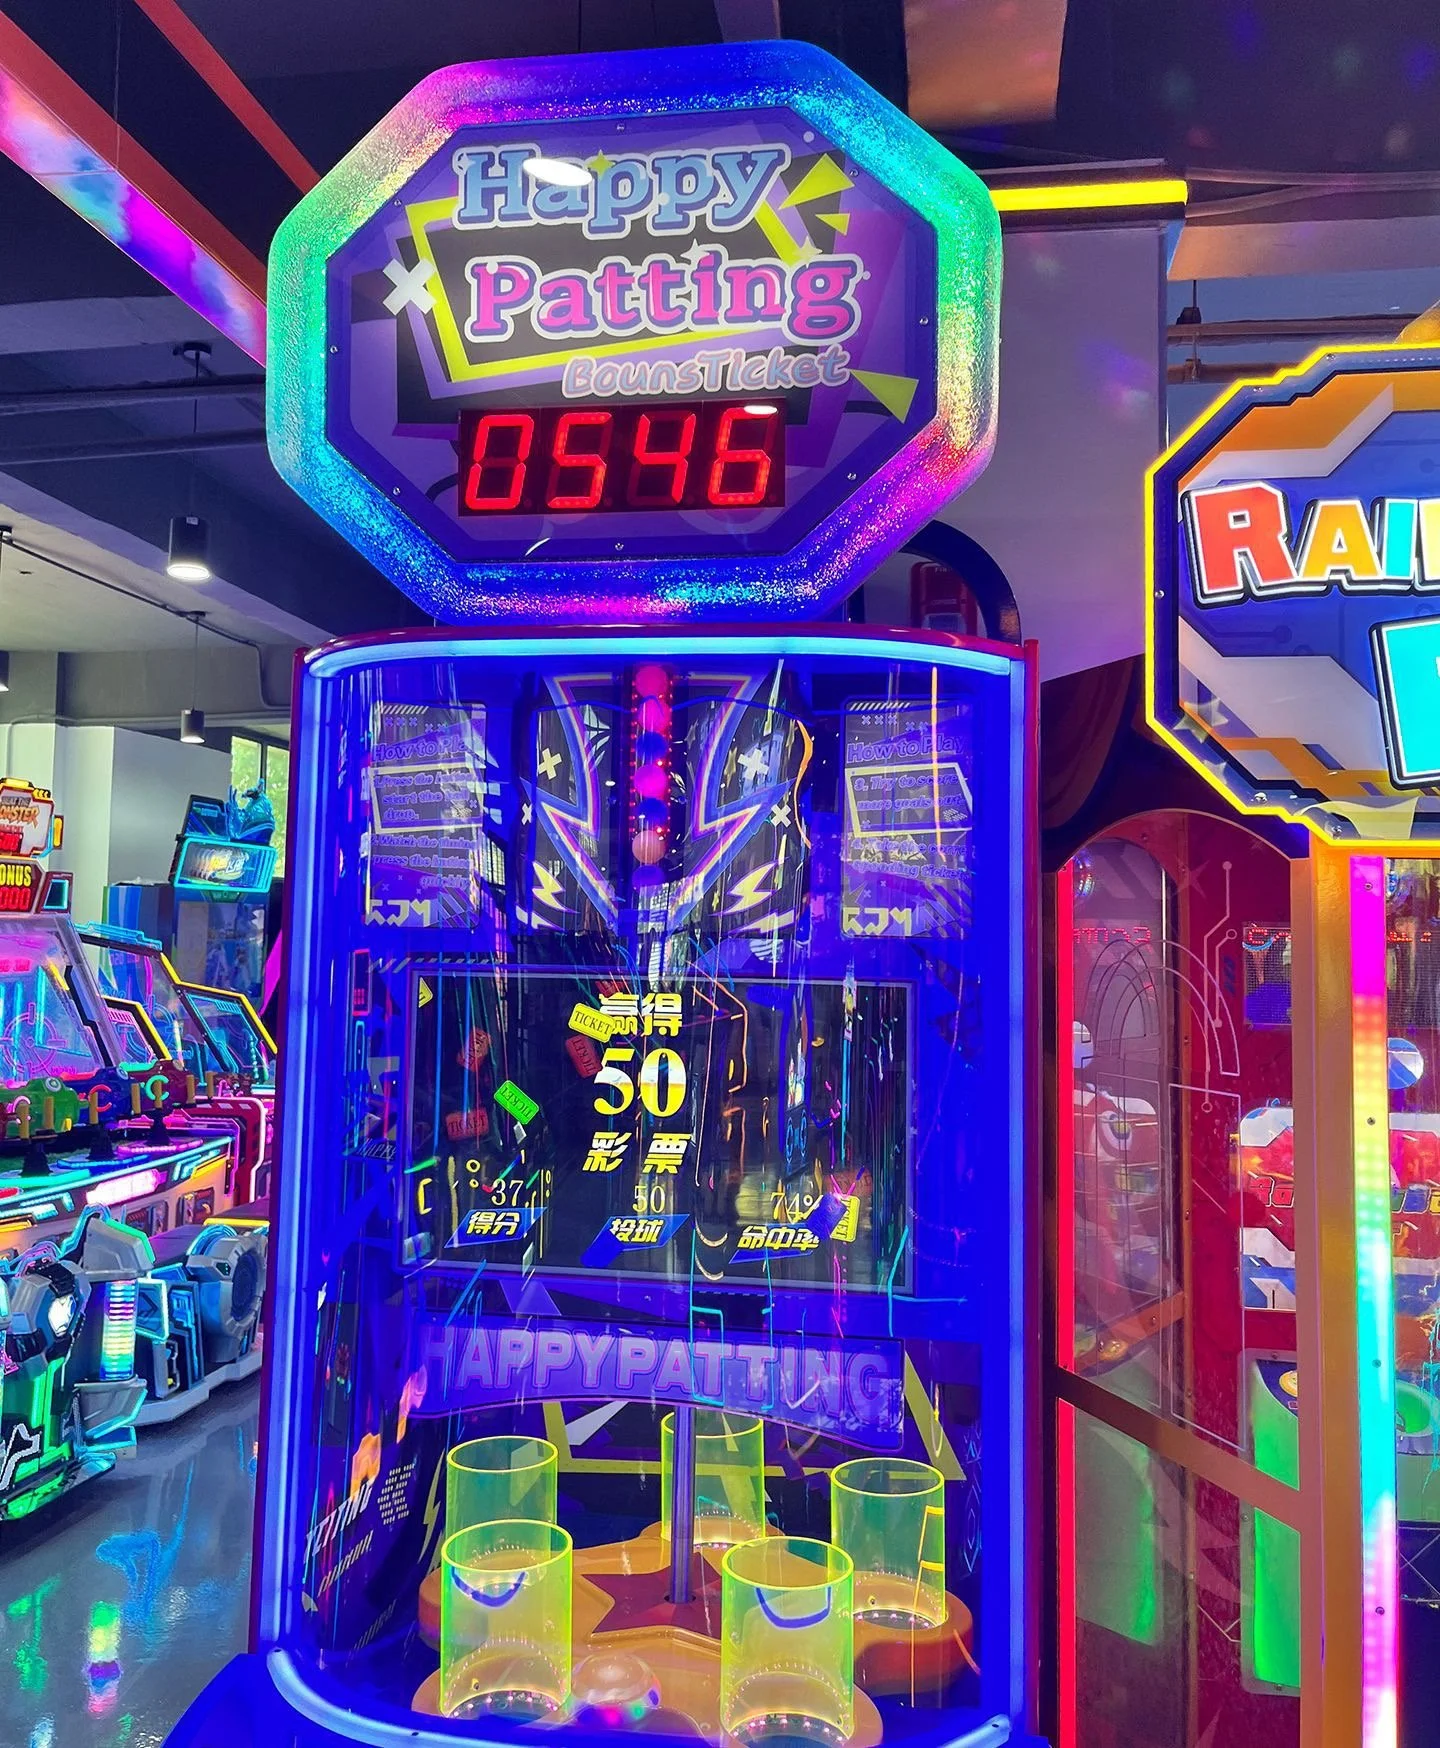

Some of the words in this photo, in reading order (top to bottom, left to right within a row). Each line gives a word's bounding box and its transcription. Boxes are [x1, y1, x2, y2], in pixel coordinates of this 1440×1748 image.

[453, 143, 791, 240] Happy
[464, 250, 864, 344] Patting
[464, 411, 776, 510] 0546
[417, 739, 437, 757] to
[847, 742, 893, 763] How
[897, 738, 919, 757] to
[920, 734, 964, 755] Play
[574, 1010, 614, 1036] TICKET
[599, 992, 683, 1037] 赢得
[593, 1047, 687, 1117] 50
[500, 1087, 533, 1118] TICKET
[582, 1131, 692, 1174] 彩票
[491, 1179, 524, 1206] 37
[632, 1185, 666, 1213] 50
[466, 1211, 520, 1236] 得分
[609, 1218, 663, 1243] 投球
[737, 1225, 821, 1251] 命中率
